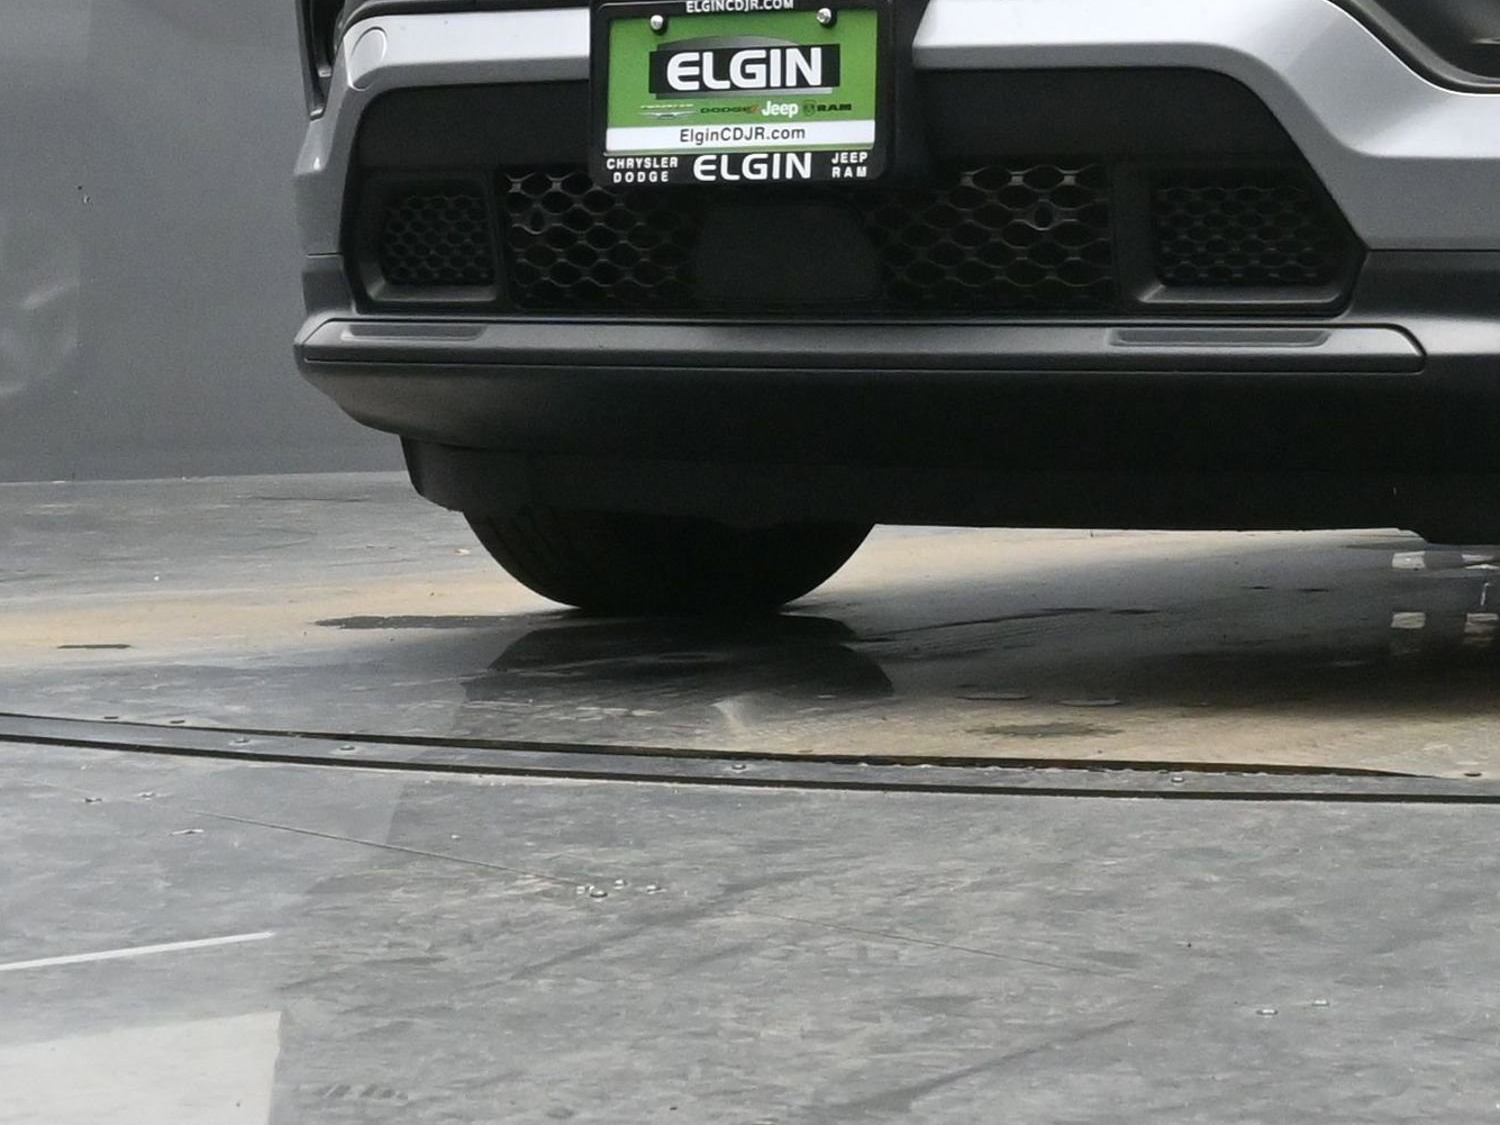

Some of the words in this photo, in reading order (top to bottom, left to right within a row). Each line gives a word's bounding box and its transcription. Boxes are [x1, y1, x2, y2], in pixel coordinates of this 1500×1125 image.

[666, 47, 822, 91] ELGIN
[761, 100, 799, 118] Jeep
[816, 103, 852, 112] RAM
[680, 127, 806, 146] ElginCDJR.com
[606, 156, 679, 170] CHRYSLER
[831, 152, 868, 164] JEEP
[693, 152, 812, 181] ELGIN
[832, 166, 867, 179] RAM
[613, 171, 669, 183] DODGE
